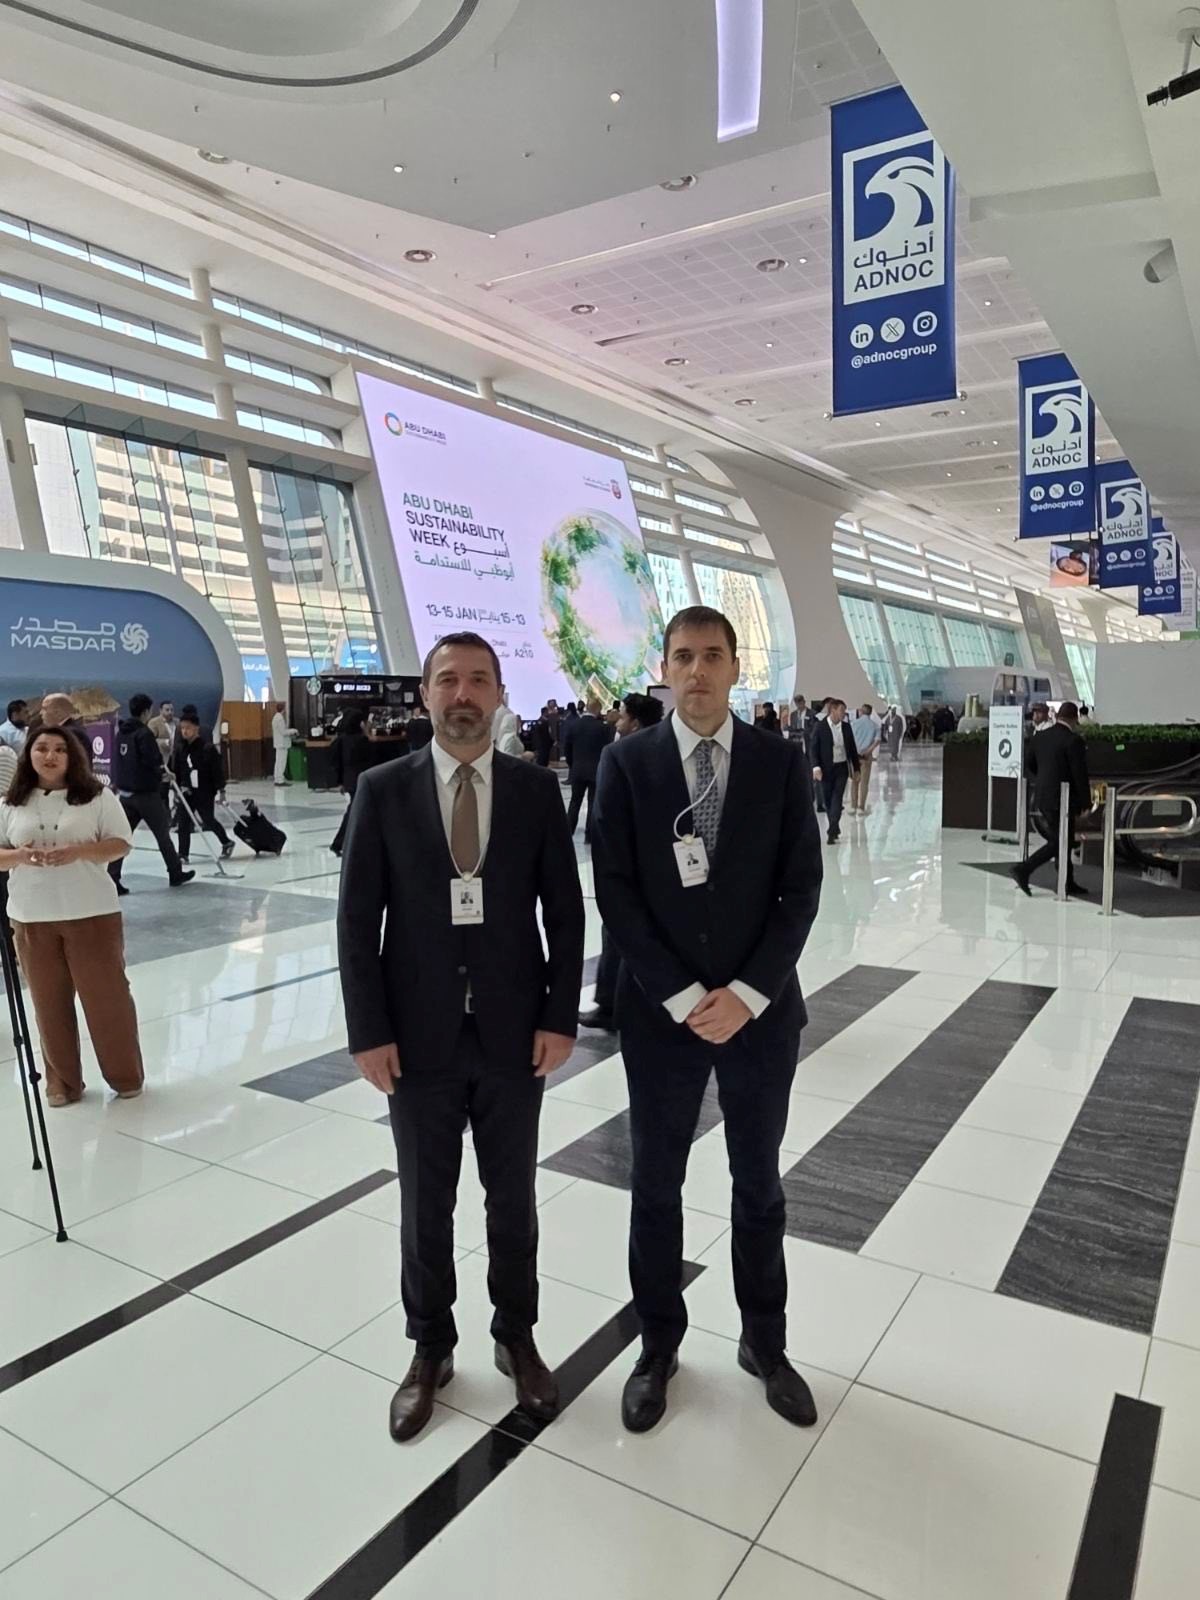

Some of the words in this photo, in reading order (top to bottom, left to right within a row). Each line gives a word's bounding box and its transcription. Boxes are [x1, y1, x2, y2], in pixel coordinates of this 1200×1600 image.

[853, 231, 934, 268] أدنوك
[854, 260, 934, 293] ADNOC
[855, 330, 869, 344] in
[851, 343, 938, 369] @adnocgroup
[404, 421, 421, 433] ABU
[1032, 452, 1082, 469] ADNOC
[403, 492, 431, 511] ABU
[433, 499, 474, 520] DHABI
[1030, 499, 1084, 513] @adnocgroup
[405, 510, 506, 542] SUSTAINABILITY
[1107, 528, 1144, 540] ADNOC
[409, 528, 450, 549] WEEK
[426, 603, 454, 618] 13-15
[455, 607, 478, 621] JAN
[10, 616, 116, 636] مصدر
[10, 632, 116, 653] MASDAR
